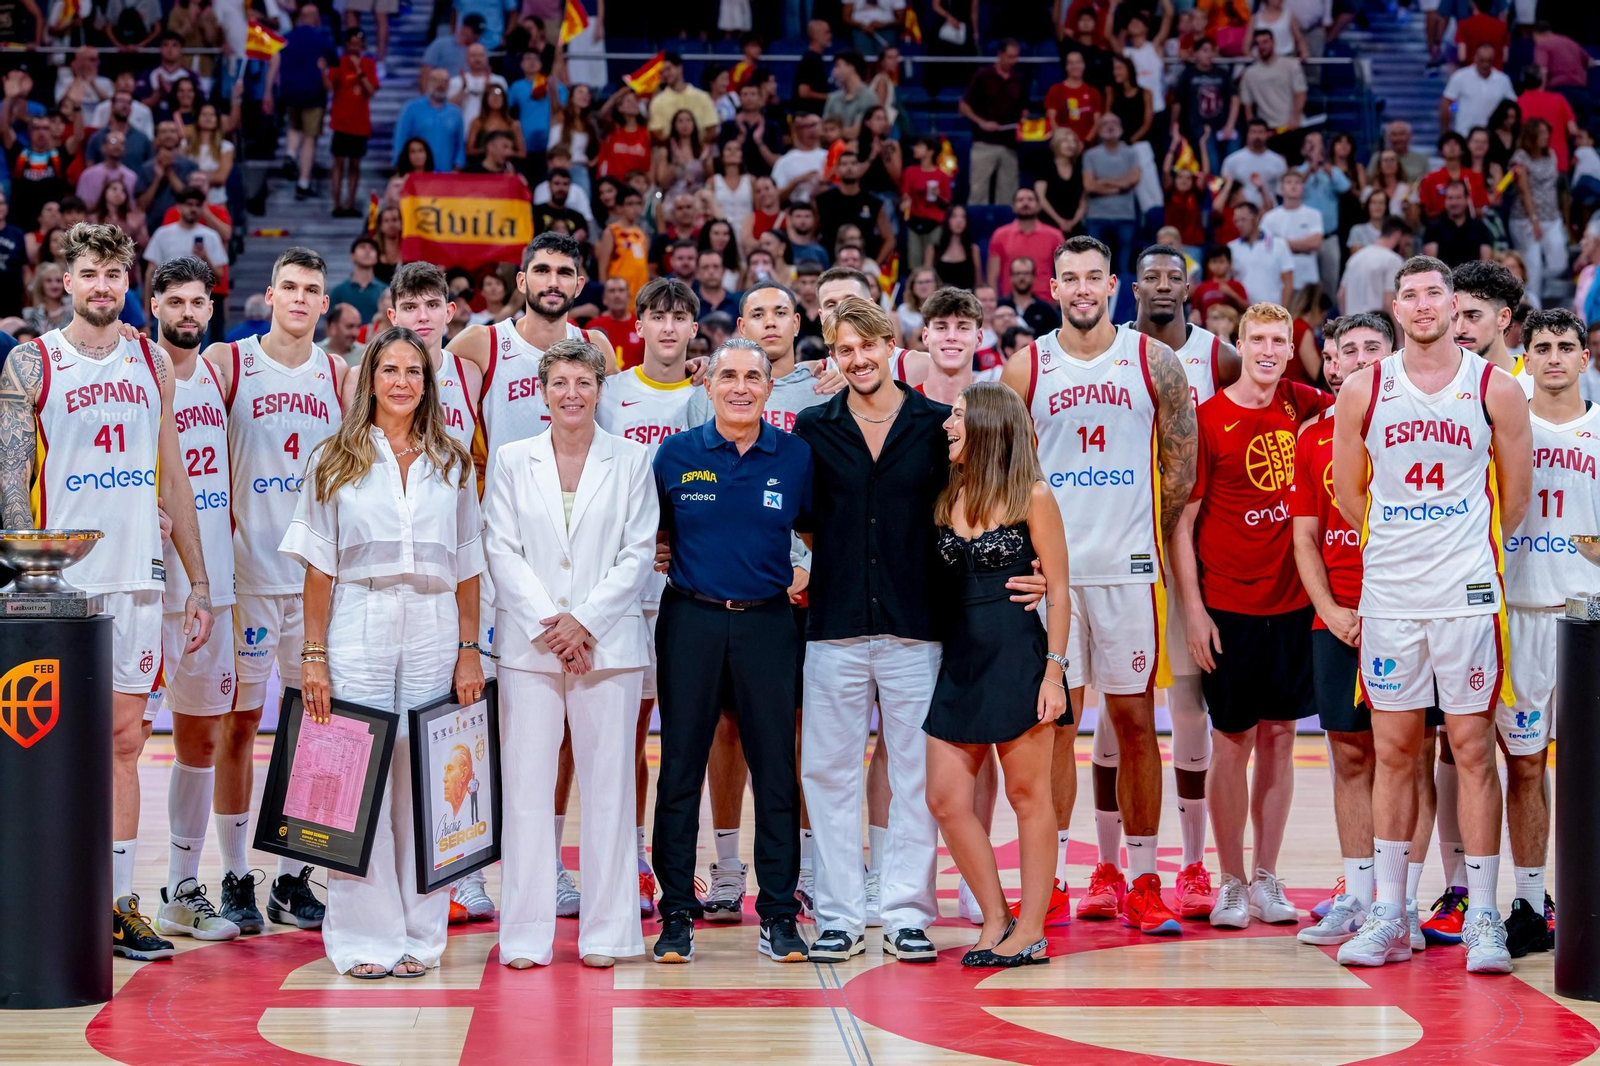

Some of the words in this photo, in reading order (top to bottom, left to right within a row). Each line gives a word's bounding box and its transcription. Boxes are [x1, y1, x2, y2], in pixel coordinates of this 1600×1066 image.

[414, 198, 516, 237] Ávila
[65, 379, 149, 414] ESPAÑA
[508, 377, 541, 402] ESP
[1049, 381, 1132, 416] ESPAÑA
[101, 409, 138, 422] hudl
[175, 402, 225, 433] SPAÑA
[253, 393, 329, 424] ESPAÑA
[94, 424, 125, 453] 41
[284, 432, 299, 460] 4
[1077, 425, 1106, 453] 14
[1385, 418, 1473, 450] ESPAÑA
[186, 446, 218, 477] 22
[1533, 447, 1596, 480] PAÑA
[253, 473, 305, 494] end
[681, 470, 718, 484] ESPAÑA
[1050, 466, 1134, 487] endesa
[1405, 462, 1444, 491] 44
[195, 489, 227, 510] des
[681, 492, 716, 501] endesa
[1383, 499, 1469, 521] endesa
[1537, 489, 1564, 518] 11
[1244, 500, 1290, 526] end
[1504, 531, 1578, 554] endes
[33, 664, 55, 674] FEB
[438, 820, 487, 852] SERGIO
